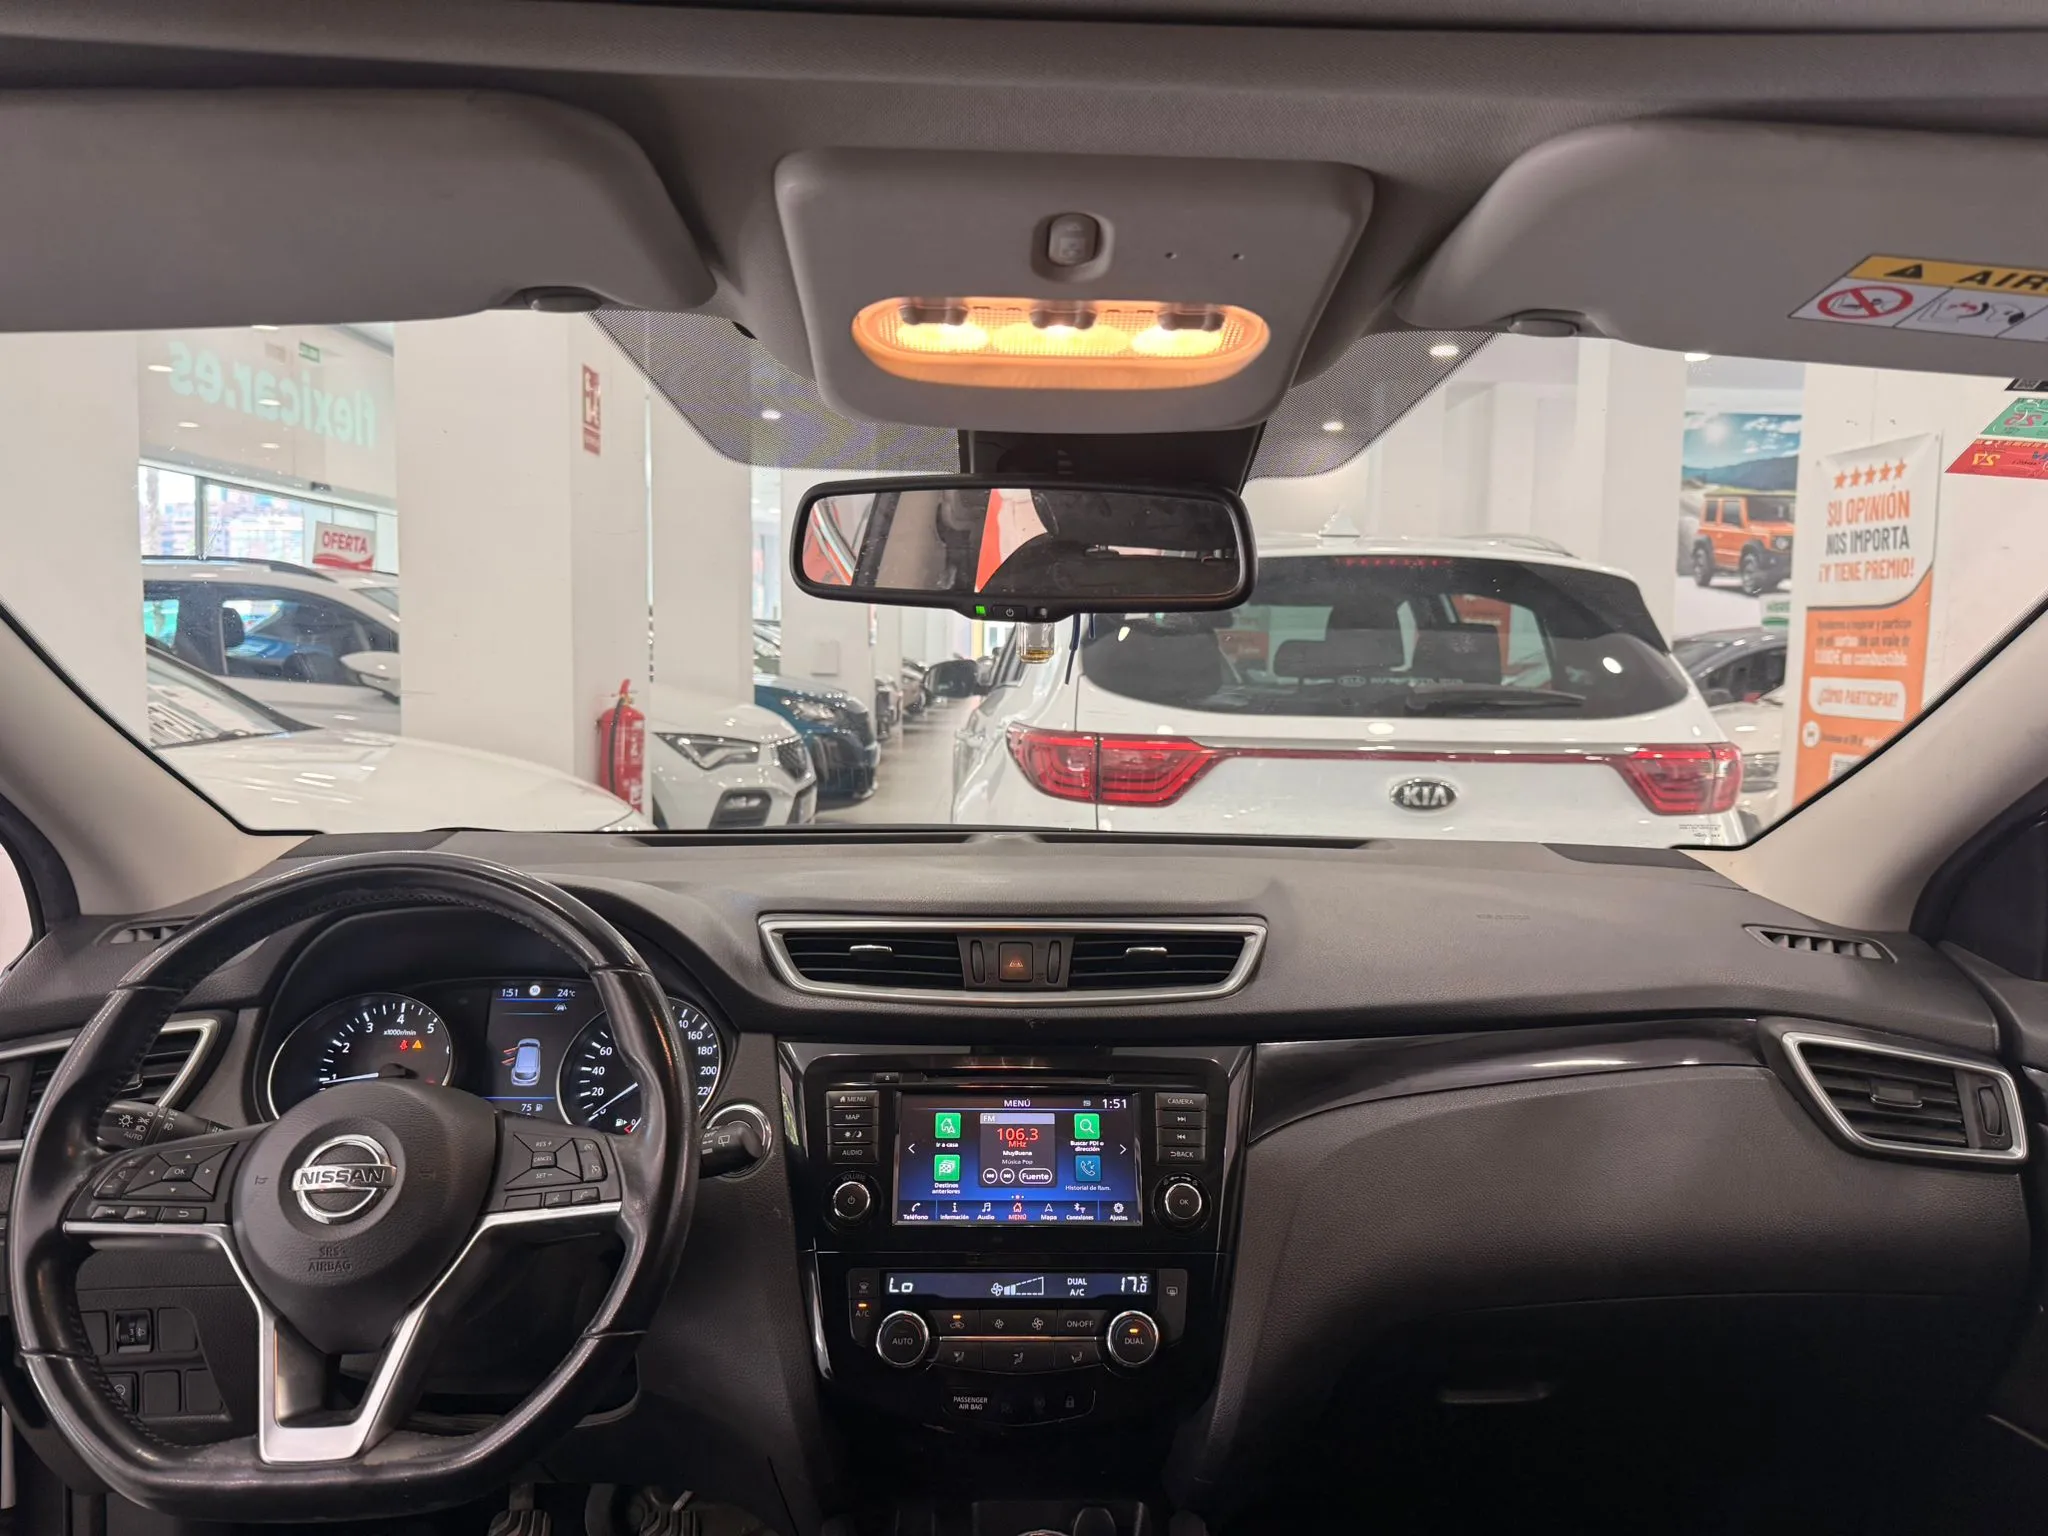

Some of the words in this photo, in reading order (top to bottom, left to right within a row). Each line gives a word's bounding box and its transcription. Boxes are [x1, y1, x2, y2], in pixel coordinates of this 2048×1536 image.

[1954, 270, 2048, 290] AIR
[1827, 500, 1842, 528] SU
[1846, 486, 1910, 524] OPINIÓN
[323, 530, 368, 554] OFERTA
[1826, 532, 1848, 556] NOS
[1850, 525, 1910, 554] IMPORTA
[1834, 561, 1862, 582] TIENE
[1864, 557, 1914, 580] PREMIO!
[1403, 786, 1447, 806] KIA
[501, 988, 519, 997] 1:51
[396, 1013, 404, 1024] 4
[365, 1022, 374, 1033] 3
[426, 1023, 435, 1033] 5
[687, 1031, 703, 1040] 160
[342, 1042, 350, 1053] 2
[600, 1046, 613, 1056] 60
[697, 1046, 713, 1055] 180
[592, 1066, 605, 1075] 40
[700, 1066, 717, 1075] 200
[592, 1087, 604, 1096] 20
[521, 1103, 532, 1112] 75
[1003, 1098, 1031, 1107] MENÚ
[1102, 1098, 1127, 1109] 1:51
[124, 1131, 143, 1141] AUTO
[997, 1128, 1039, 1141] 106.3
[300, 1167, 385, 1185] NISSAN
[1022, 1172, 1050, 1180] Fuente
[1110, 1214, 1128, 1222] Ajustes
[308, 1261, 352, 1273] AIRBAG
[889, 1277, 914, 1293] Lo
[1069, 1289, 1085, 1297] A/C
[1124, 1337, 1145, 1345] DUAL
[953, 1395, 988, 1404] PASSENGER
[970, 1403, 983, 1411] BAG
